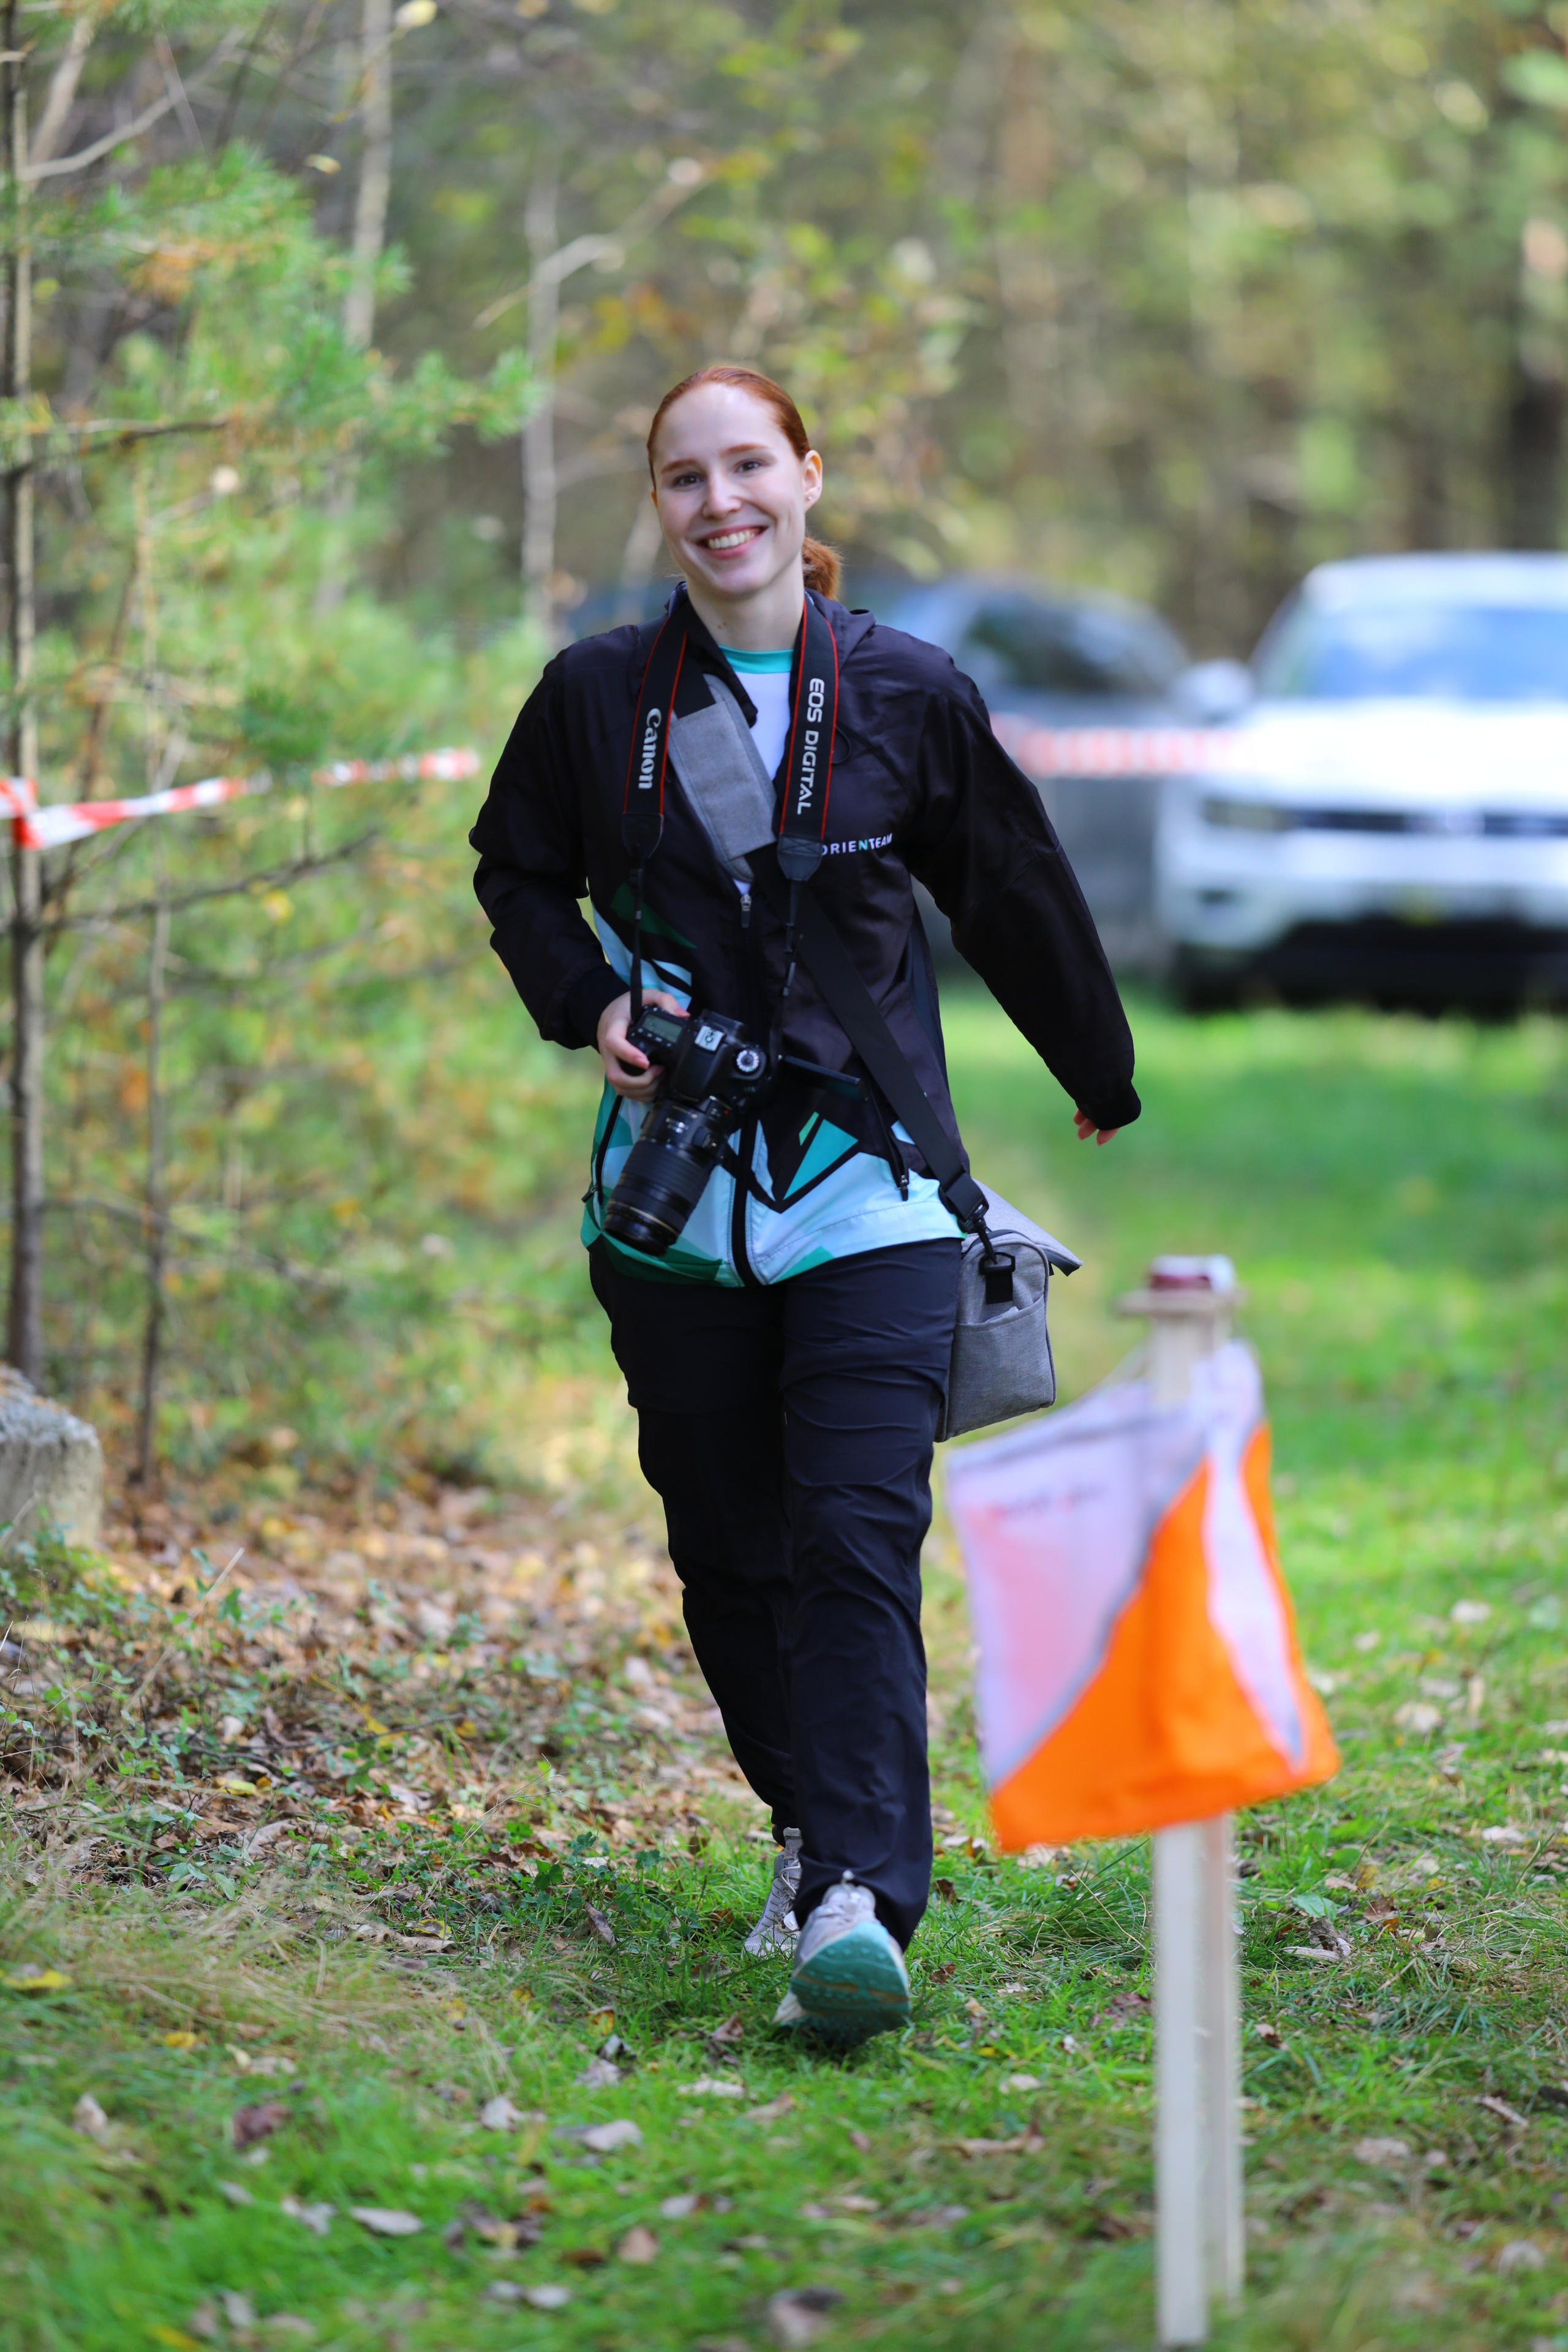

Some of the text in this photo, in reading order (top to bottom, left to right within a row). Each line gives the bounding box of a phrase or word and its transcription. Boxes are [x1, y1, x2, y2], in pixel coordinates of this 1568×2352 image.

[638, 708, 662, 789] Canon
[797, 677, 825, 815] EOS DIGITAL
